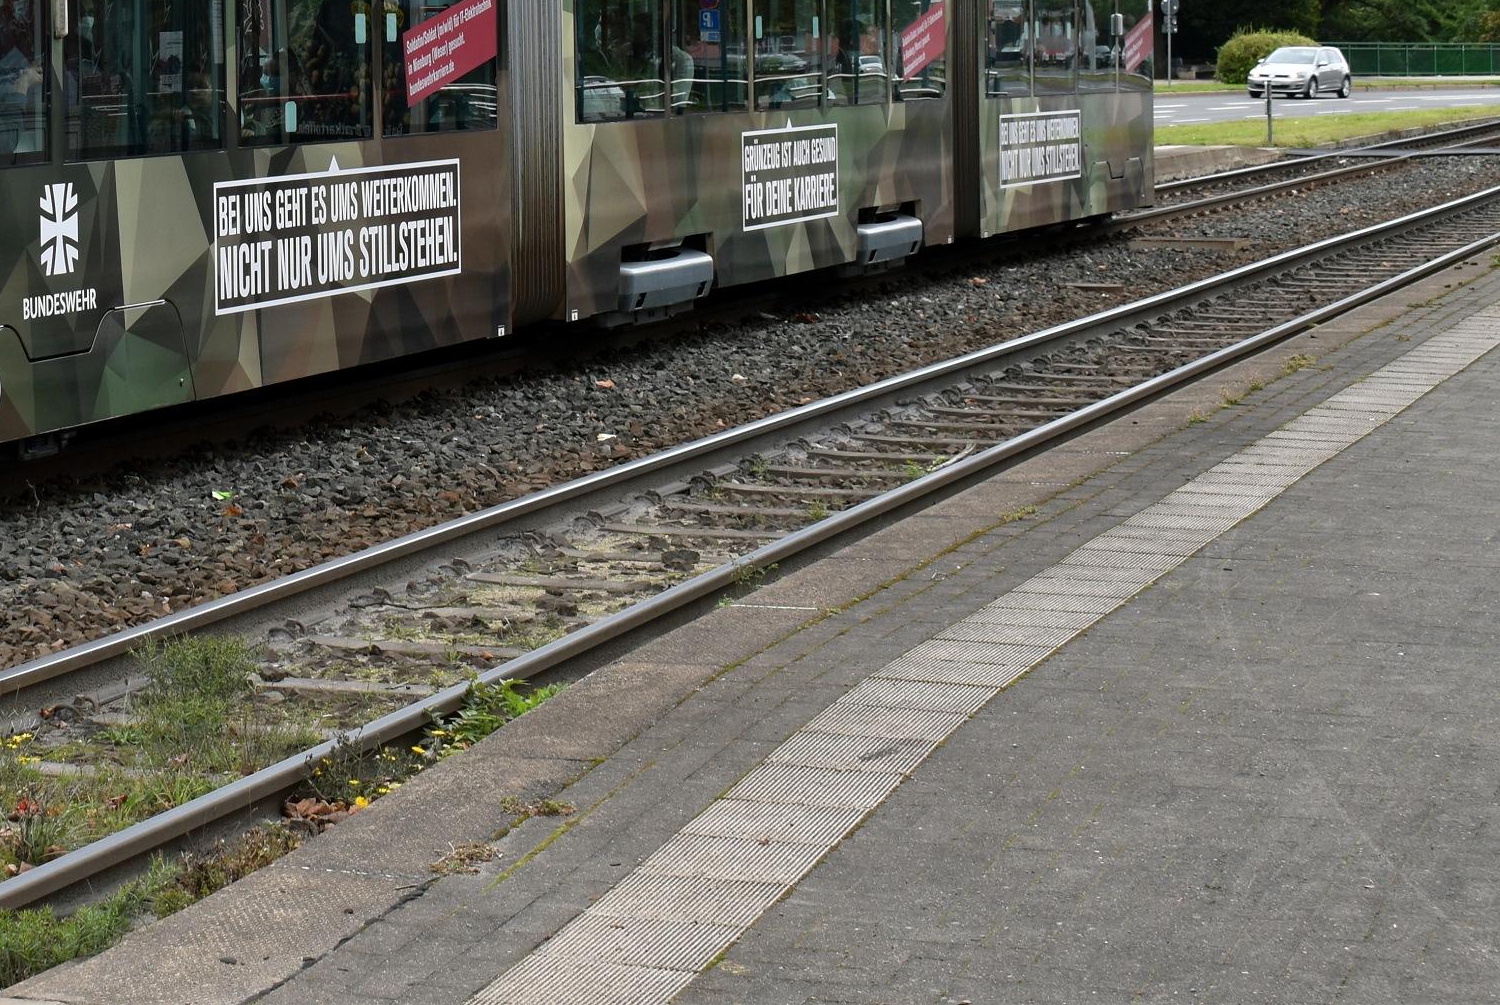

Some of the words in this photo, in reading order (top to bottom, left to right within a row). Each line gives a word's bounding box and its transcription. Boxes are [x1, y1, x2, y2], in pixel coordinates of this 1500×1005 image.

[744, 138, 780, 172] GRÜNZEUG
[781, 141, 792, 168] IST
[793, 139, 810, 166] AUCH
[811, 137, 836, 164] GESUND
[219, 194, 240, 237] BEI
[245, 191, 271, 234] UNS
[275, 187, 308, 229] GEHT
[311, 184, 327, 225] ES
[330, 181, 358, 222] UMS
[361, 171, 457, 218] WEITERKOMMEN.
[745, 175, 764, 220] FÜR
[766, 178, 792, 216] DEINE
[794, 172, 837, 211] KARRIERE.
[220, 240, 272, 300] NICHT
[277, 235, 312, 291] NUR
[317, 228, 354, 285] UMS
[359, 216, 457, 278] STILLSTEHEN.
[23, 288, 97, 320] BUNDESWEHR
